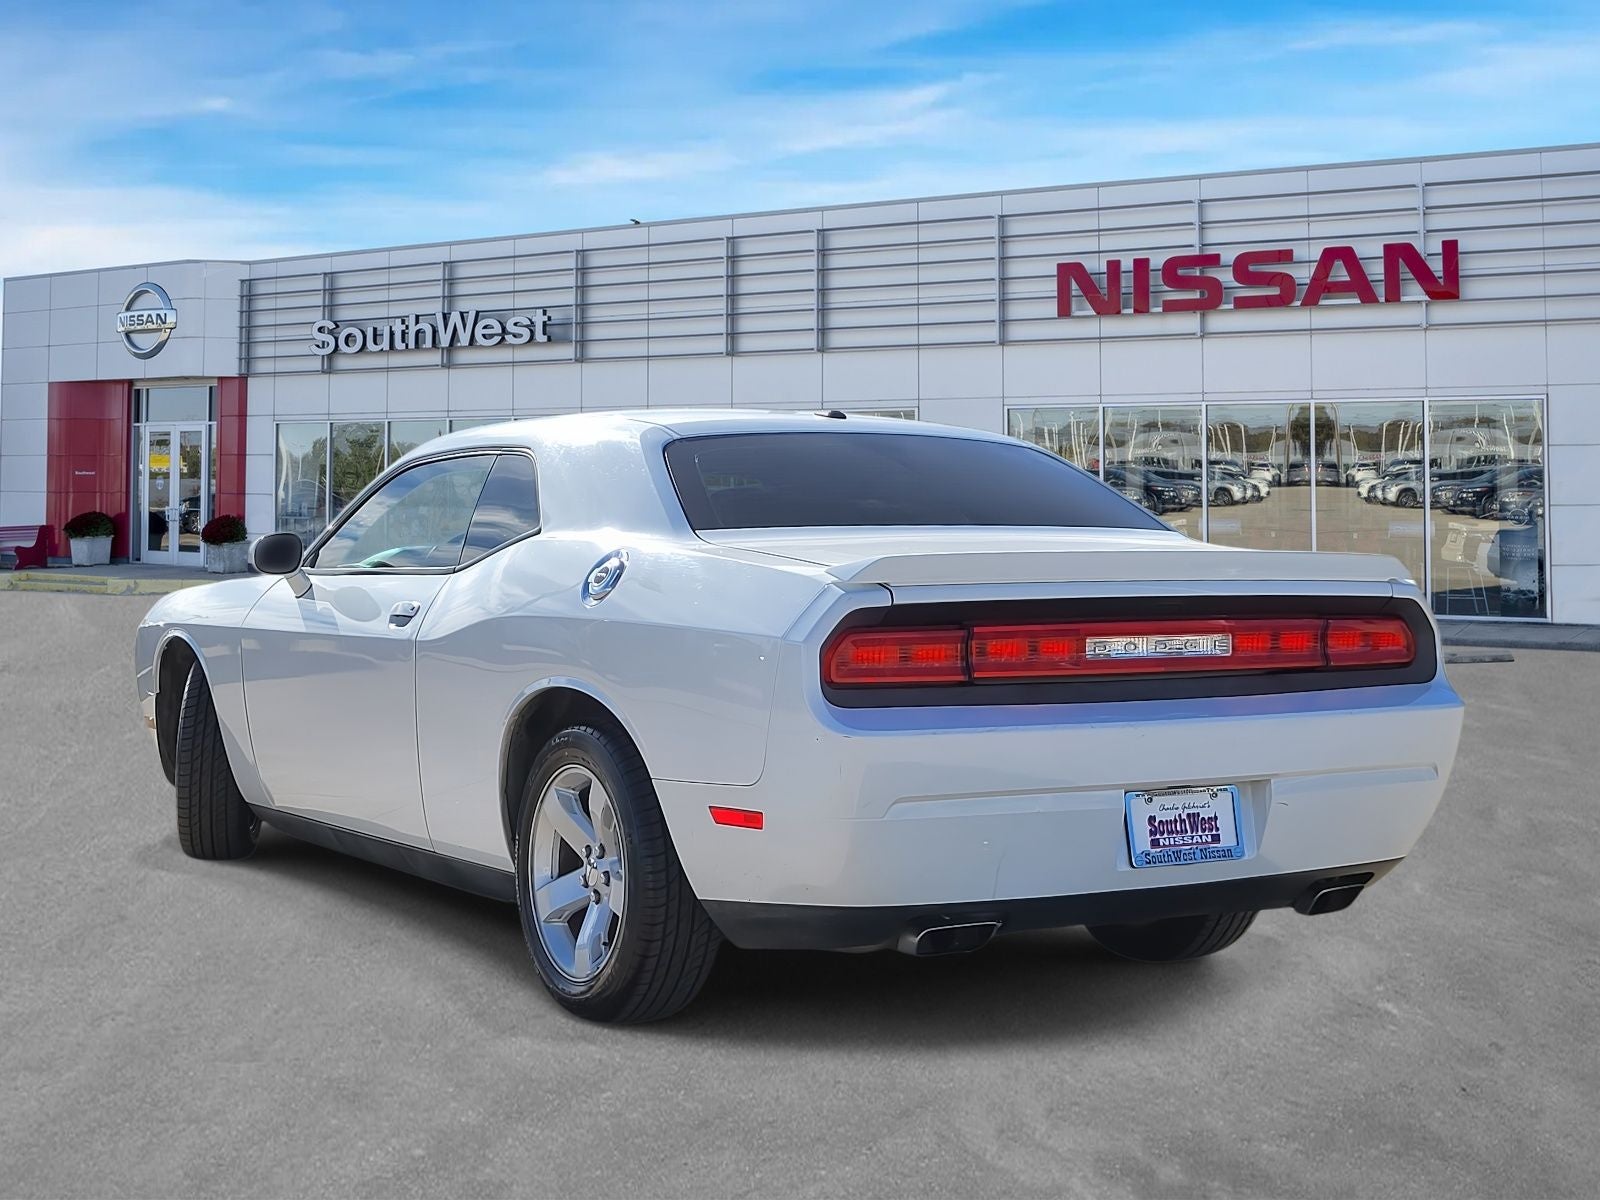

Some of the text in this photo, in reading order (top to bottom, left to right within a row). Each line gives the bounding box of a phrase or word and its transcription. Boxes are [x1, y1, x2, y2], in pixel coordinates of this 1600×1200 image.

[1056, 239, 1460, 318] NISSAN
[119, 312, 167, 328] NISSAN
[309, 308, 551, 356] SouthWest
[1093, 638, 1229, 653] DODGE
[1148, 811, 1220, 838] SouthWest
[1159, 834, 1212, 846] NISSAN
[1144, 847, 1234, 865] SouthWest Nissan
